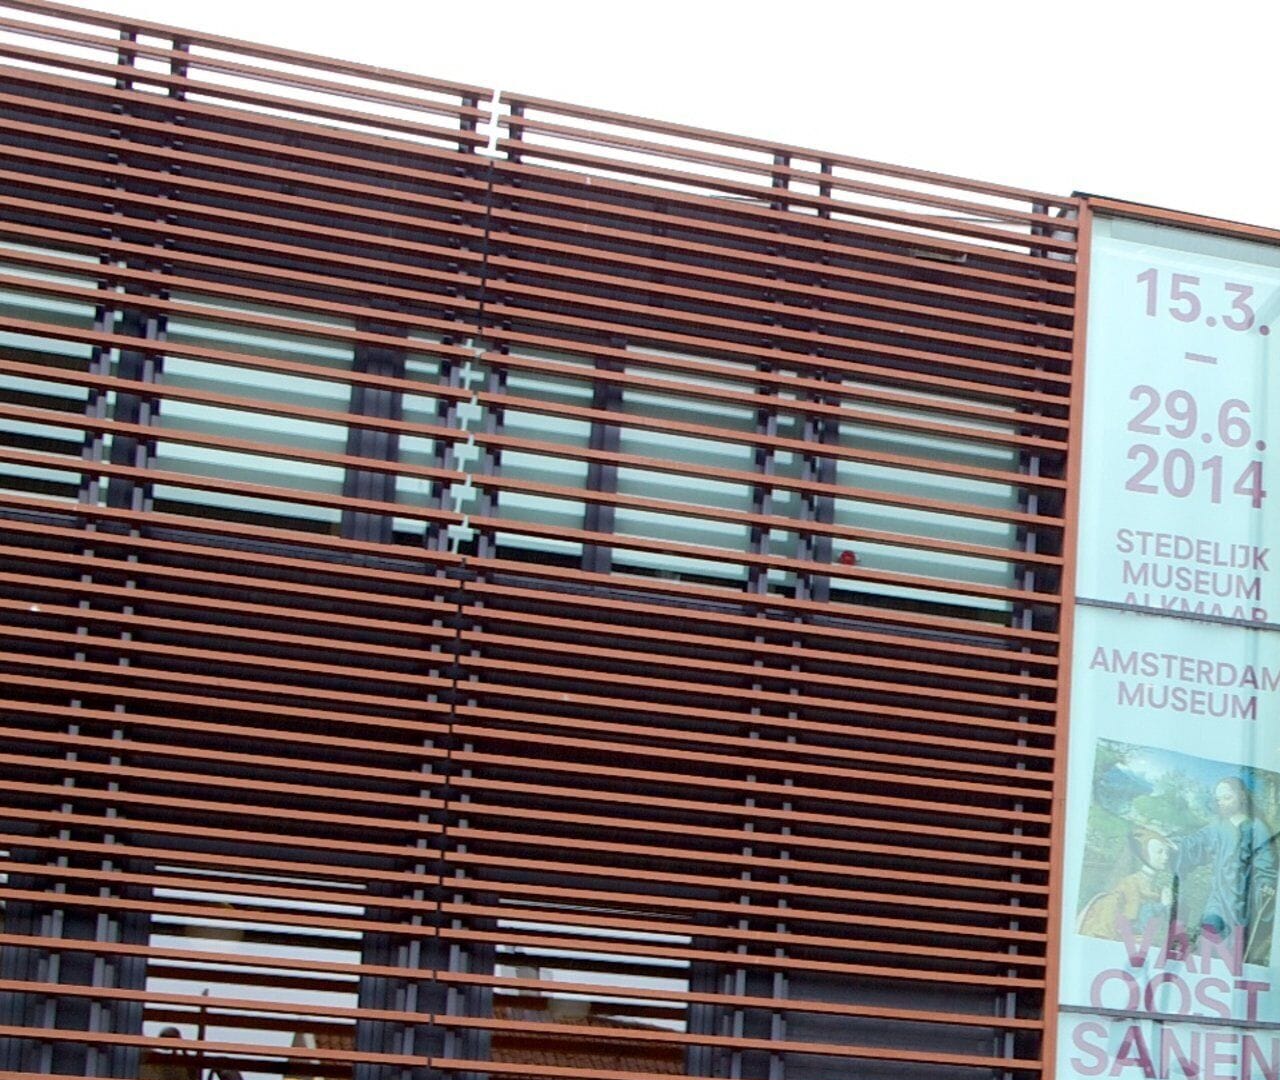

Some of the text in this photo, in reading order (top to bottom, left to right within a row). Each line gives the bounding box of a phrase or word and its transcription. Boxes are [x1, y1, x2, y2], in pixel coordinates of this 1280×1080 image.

[1136, 267, 1270, 336] 15.3.
[1127, 384, 1266, 451] 29.6.
[1124, 443, 1267, 509] 2014
[1116, 528, 1271, 571] STEDELIJK
[1121, 560, 1261, 601] MUSEUM
[1116, 681, 1257, 721] MUSEUM
[1116, 916, 1245, 977] VAN
[1089, 968, 1271, 1022] OOST
